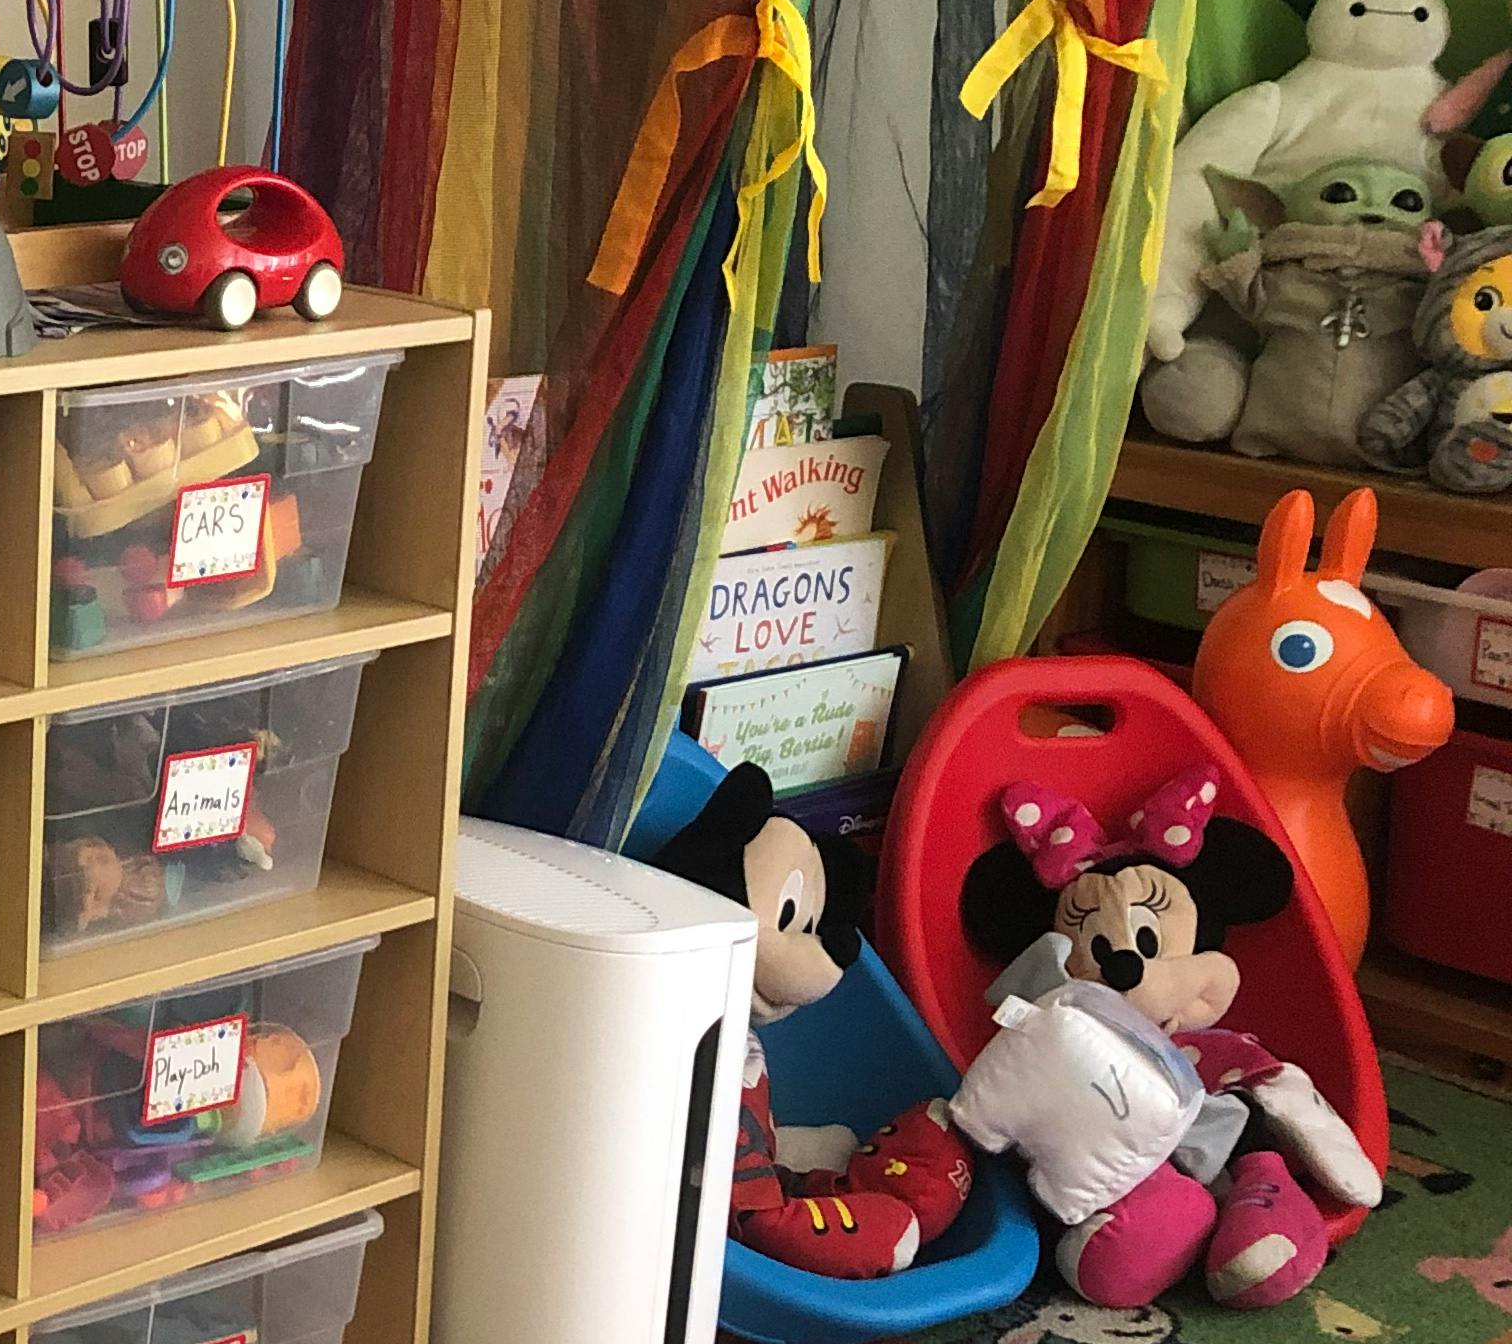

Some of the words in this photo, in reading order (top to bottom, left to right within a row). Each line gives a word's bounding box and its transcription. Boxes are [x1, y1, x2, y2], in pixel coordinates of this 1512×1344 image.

[68, 129, 101, 182] STOP
[114, 138, 147, 162] TOP
[762, 454, 867, 504] Walking
[180, 502, 245, 544] CARS
[709, 565, 854, 622] DRAGONS
[734, 610, 818, 654] LOVE
[164, 786, 241, 819] Animals
